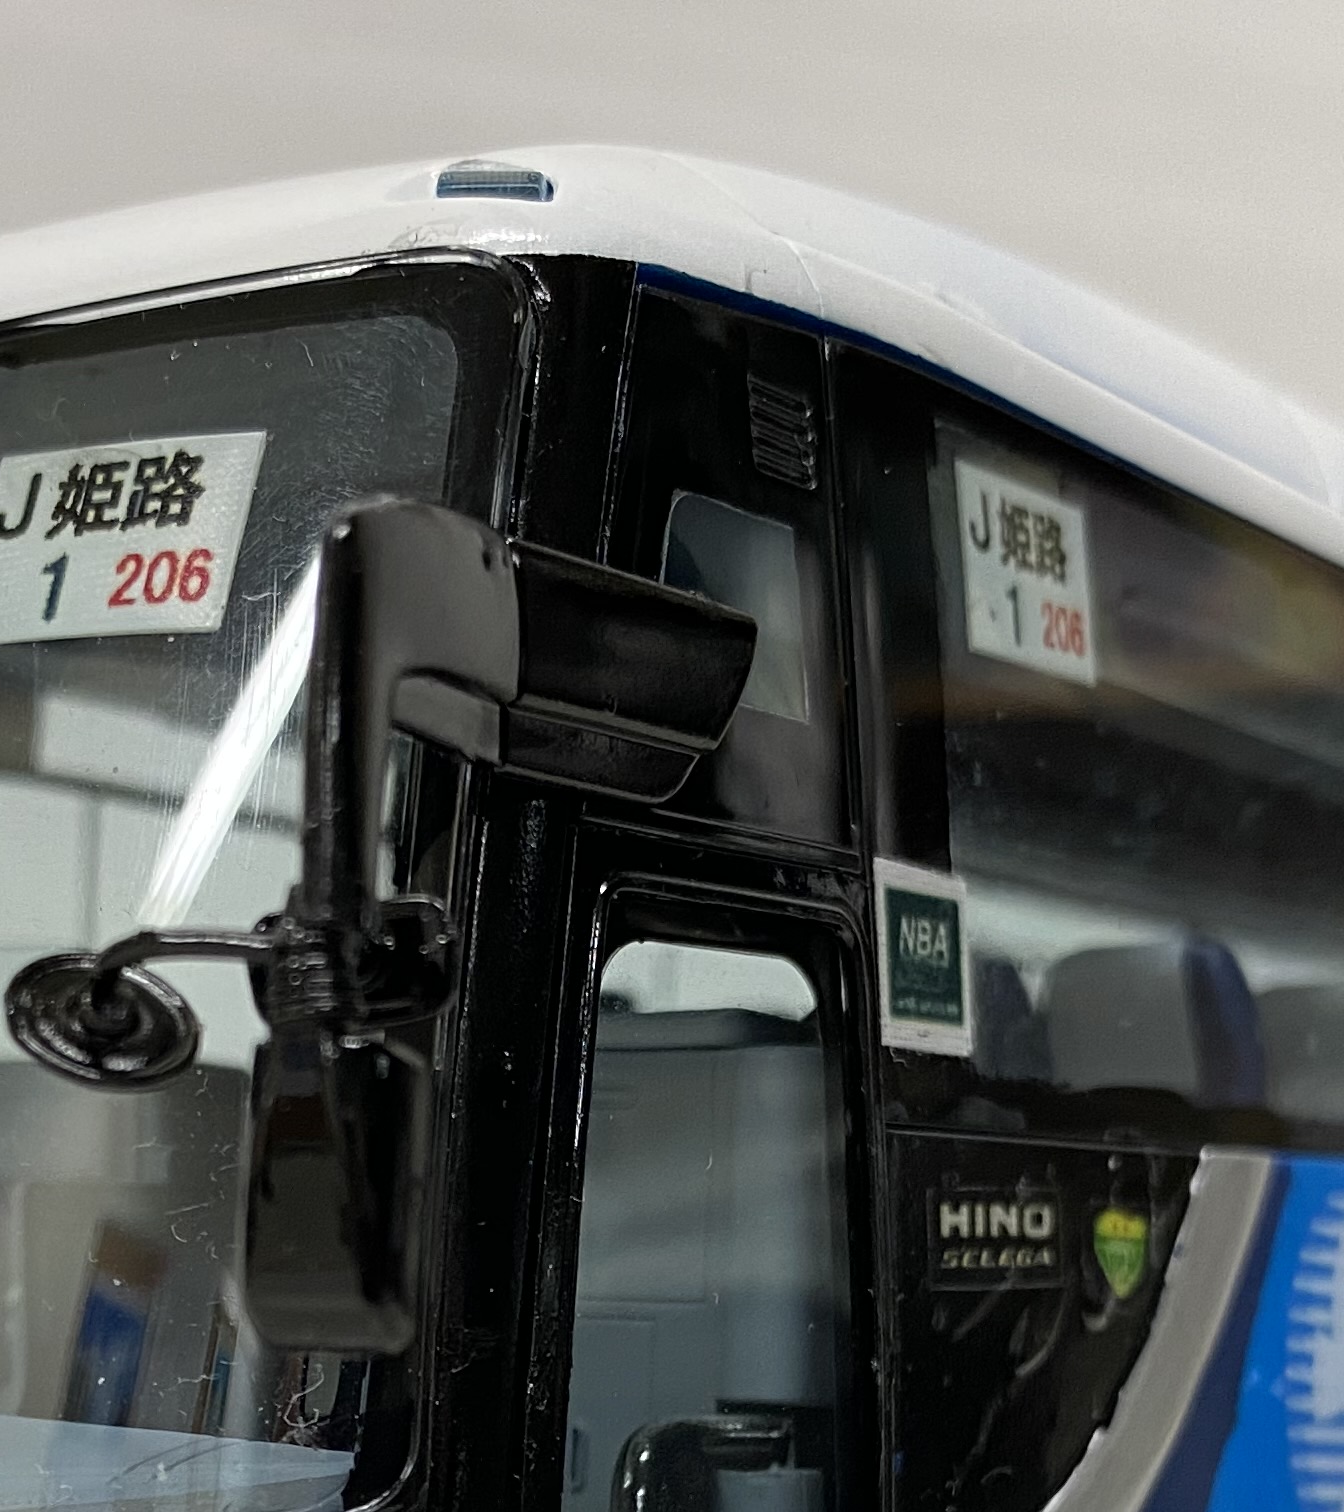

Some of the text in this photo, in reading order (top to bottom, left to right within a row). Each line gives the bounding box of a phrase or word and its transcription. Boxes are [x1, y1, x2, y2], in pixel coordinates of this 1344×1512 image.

[40, 548, 213, 623] 1 206
[1005, 585, 1086, 656] 1 206
[899, 914, 950, 969] NBA
[939, 1202, 1053, 1239] HINO
